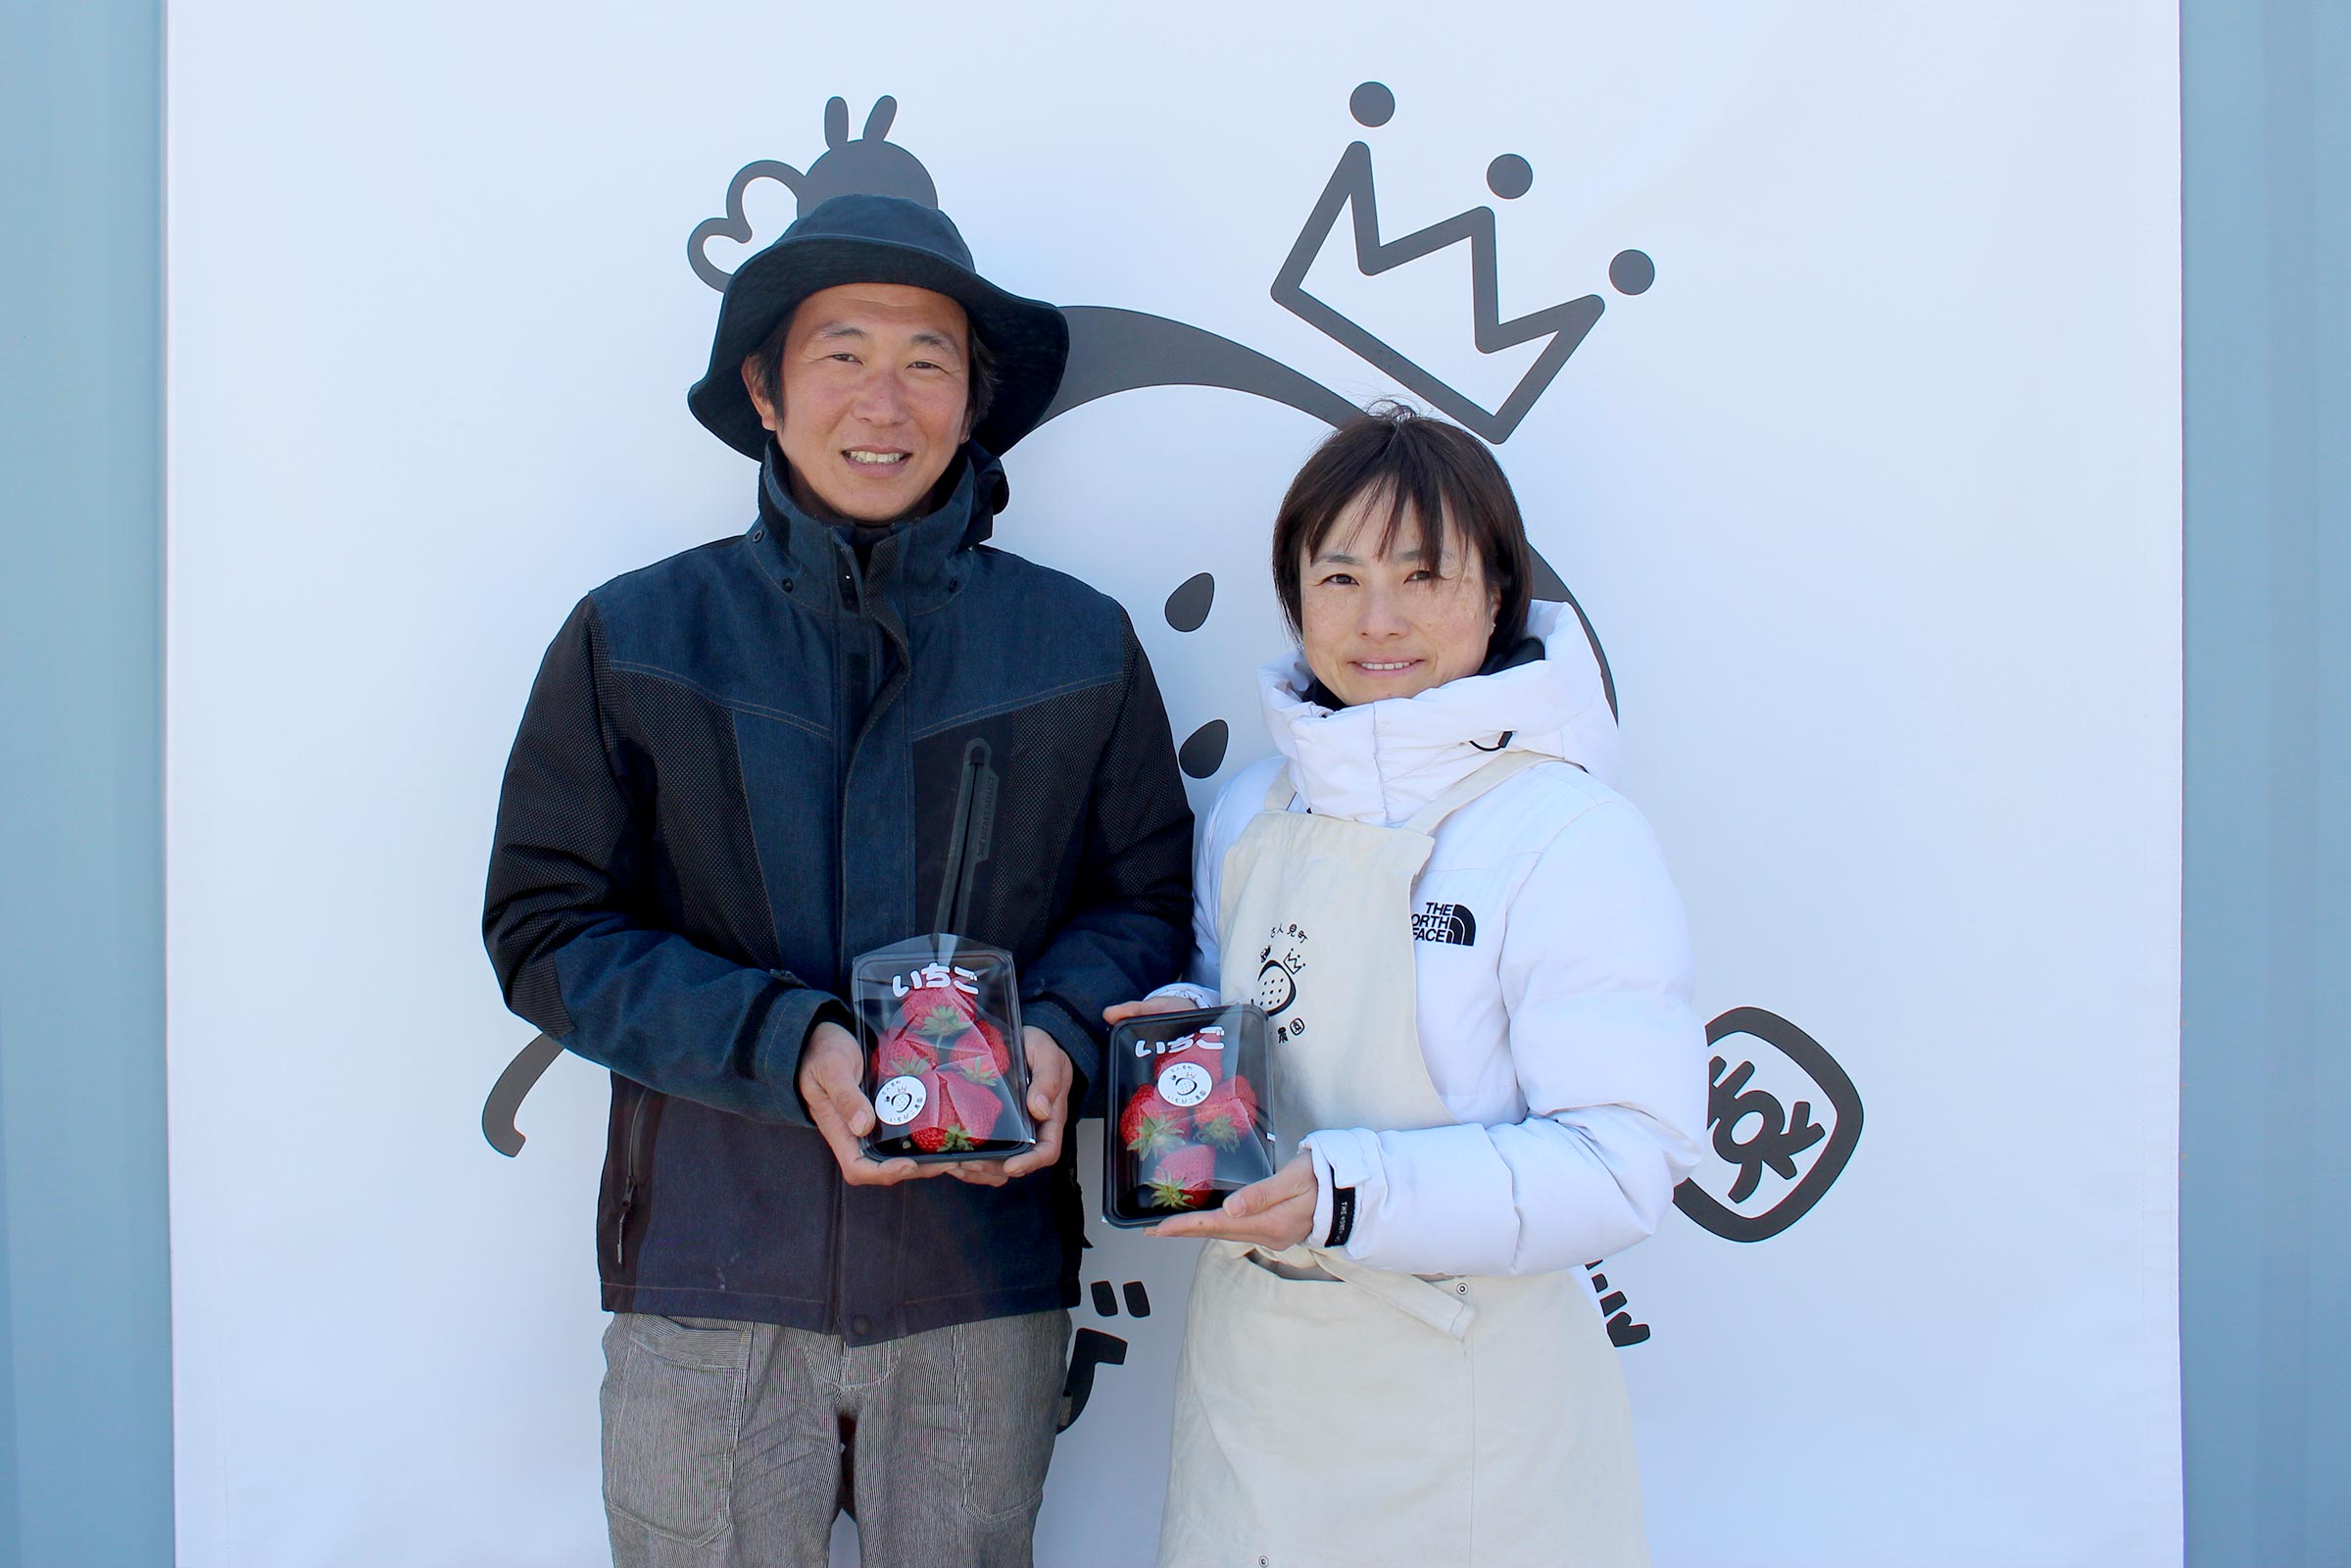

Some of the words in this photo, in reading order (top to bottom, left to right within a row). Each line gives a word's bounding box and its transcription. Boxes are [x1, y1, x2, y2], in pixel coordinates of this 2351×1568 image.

[1411, 913, 1450, 929] ORTH
[1426, 902, 1453, 916] THE
[892, 961, 980, 998] いちご
[1134, 1025, 1226, 1059] いちご
